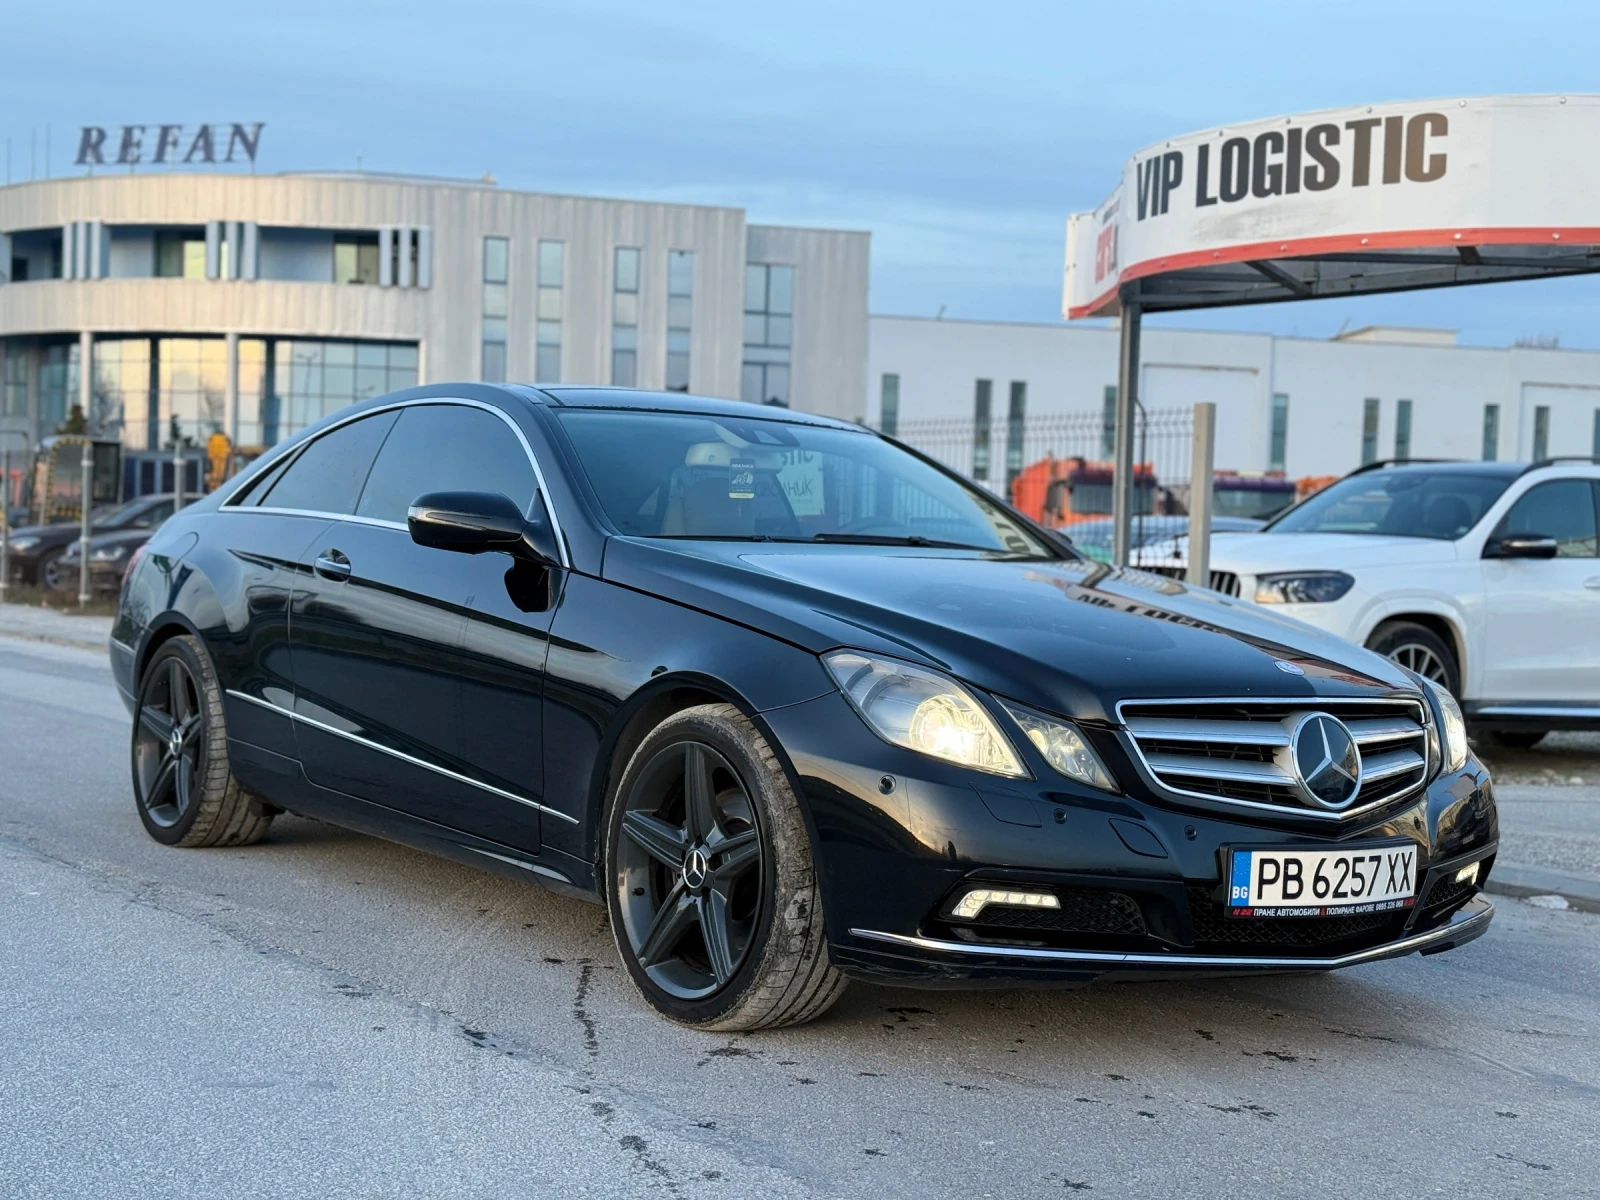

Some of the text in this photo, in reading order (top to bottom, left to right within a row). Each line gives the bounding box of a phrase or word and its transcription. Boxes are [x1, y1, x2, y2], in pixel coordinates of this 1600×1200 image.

[74, 121, 267, 165] REFAN
[1136, 112, 1449, 221] VIP LOGISTIC
[1232, 886, 1248, 899] BG
[1257, 851, 1413, 900] PB 6257 XX
[1253, 908, 1276, 918] ПРАНЕ
[1276, 908, 1320, 917] АВТОМОБИЛИ
[1326, 906, 1355, 916] ПОЛИРАНЕ
[1355, 904, 1375, 914] ФАРОВЕ
